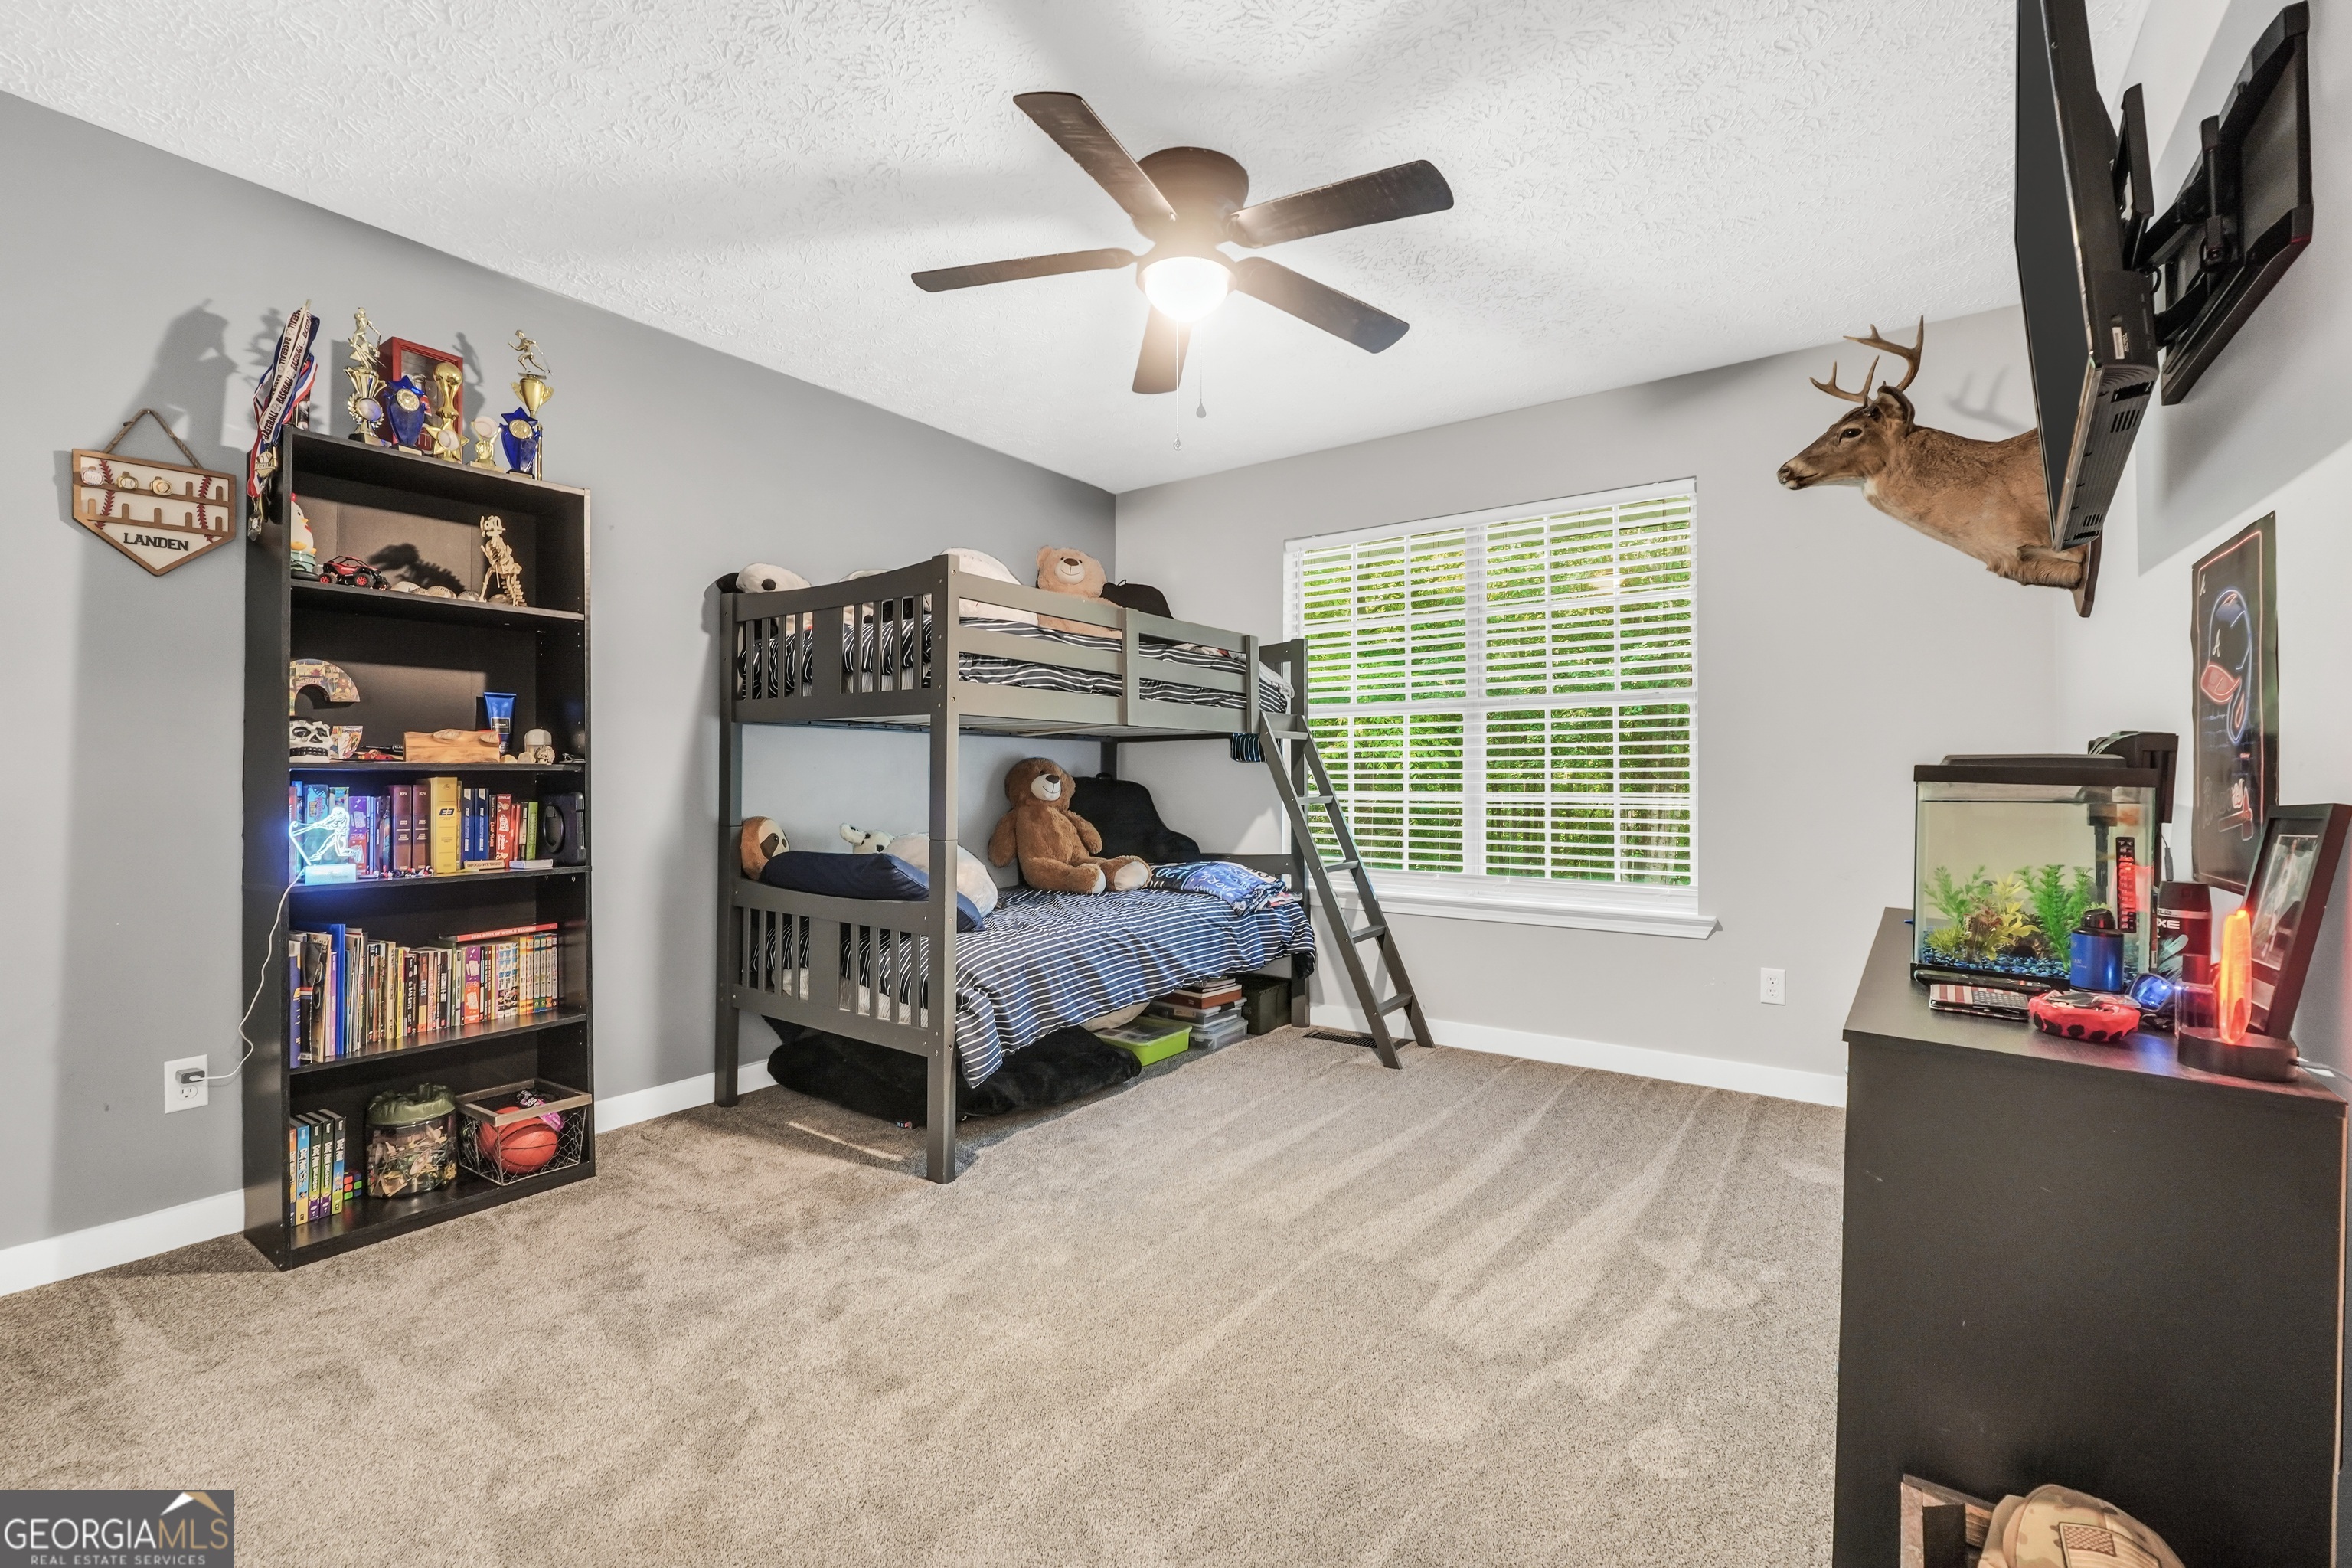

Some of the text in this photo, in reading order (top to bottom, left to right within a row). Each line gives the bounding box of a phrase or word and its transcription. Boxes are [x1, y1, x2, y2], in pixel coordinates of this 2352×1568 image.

[278, 336, 291, 365] BASEBALL
[290, 344, 303, 372] BASEBALL
[276, 377, 294, 405] BASEBALL
[261, 410, 278, 441] BASEBALL
[123, 532, 189, 551] LANDEN
[1156, 867, 1190, 880] 120
[1199, 874, 1236, 892] MORE
